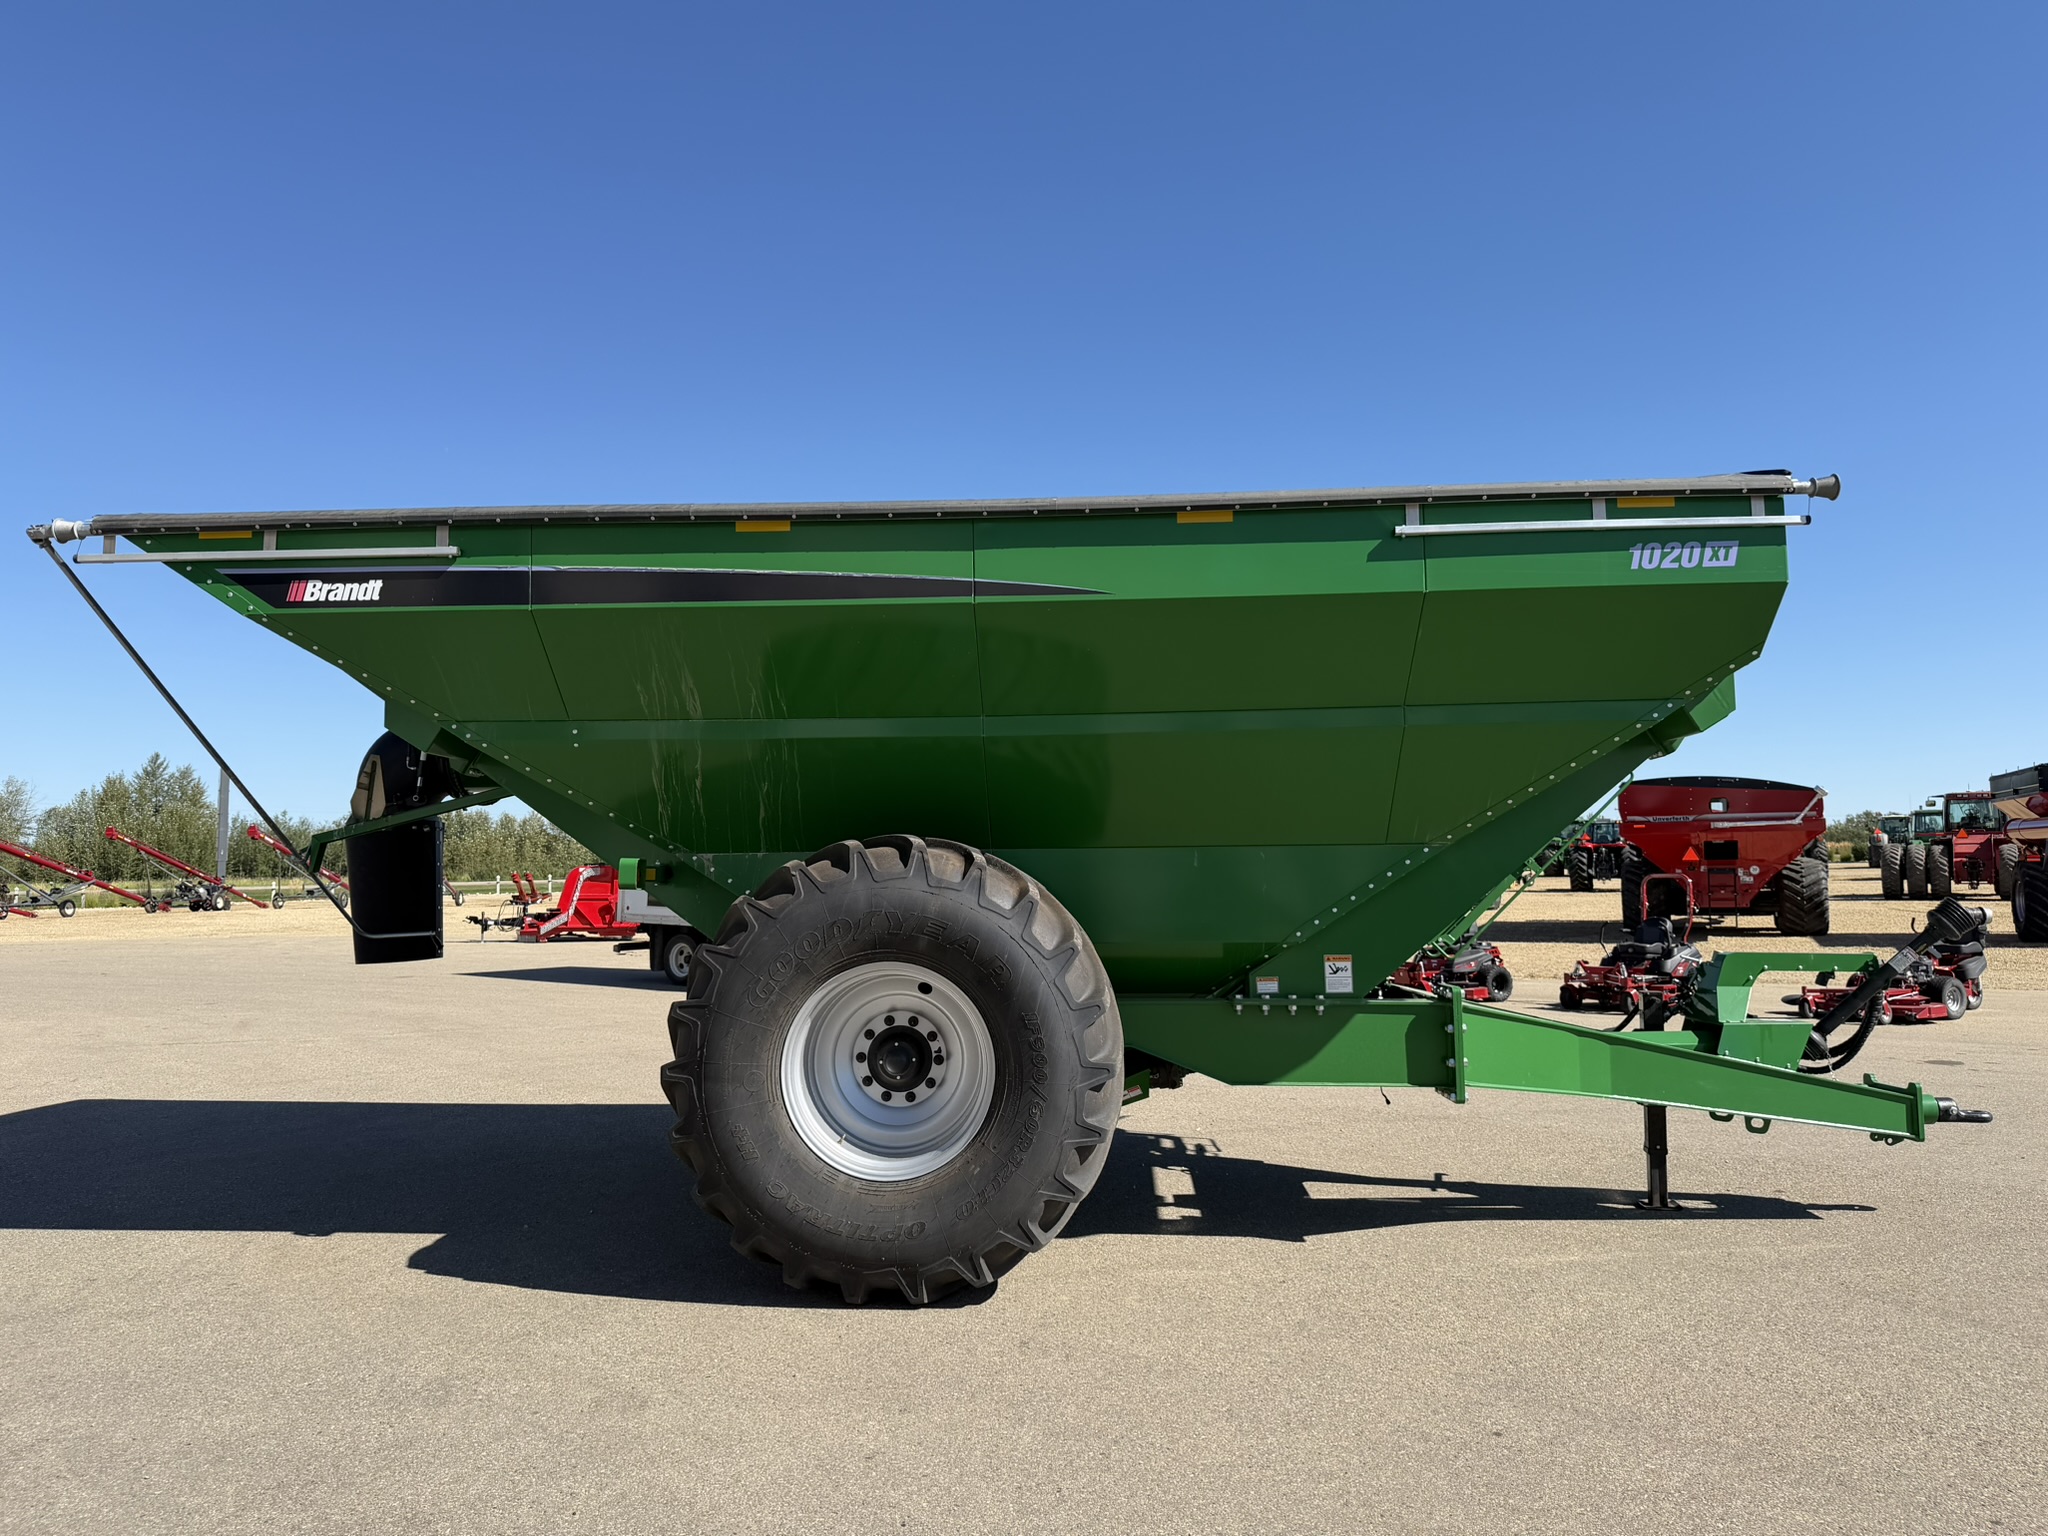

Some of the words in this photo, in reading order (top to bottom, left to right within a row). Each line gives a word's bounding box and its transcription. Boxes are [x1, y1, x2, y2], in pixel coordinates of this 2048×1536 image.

[1629, 541, 1702, 570] 1020
[1706, 544, 1735, 563] XT
[303, 579, 383, 602] Brandt
[748, 910, 1012, 1008] GOODYEAR
[766, 1179, 927, 1243] OPTITRAC
